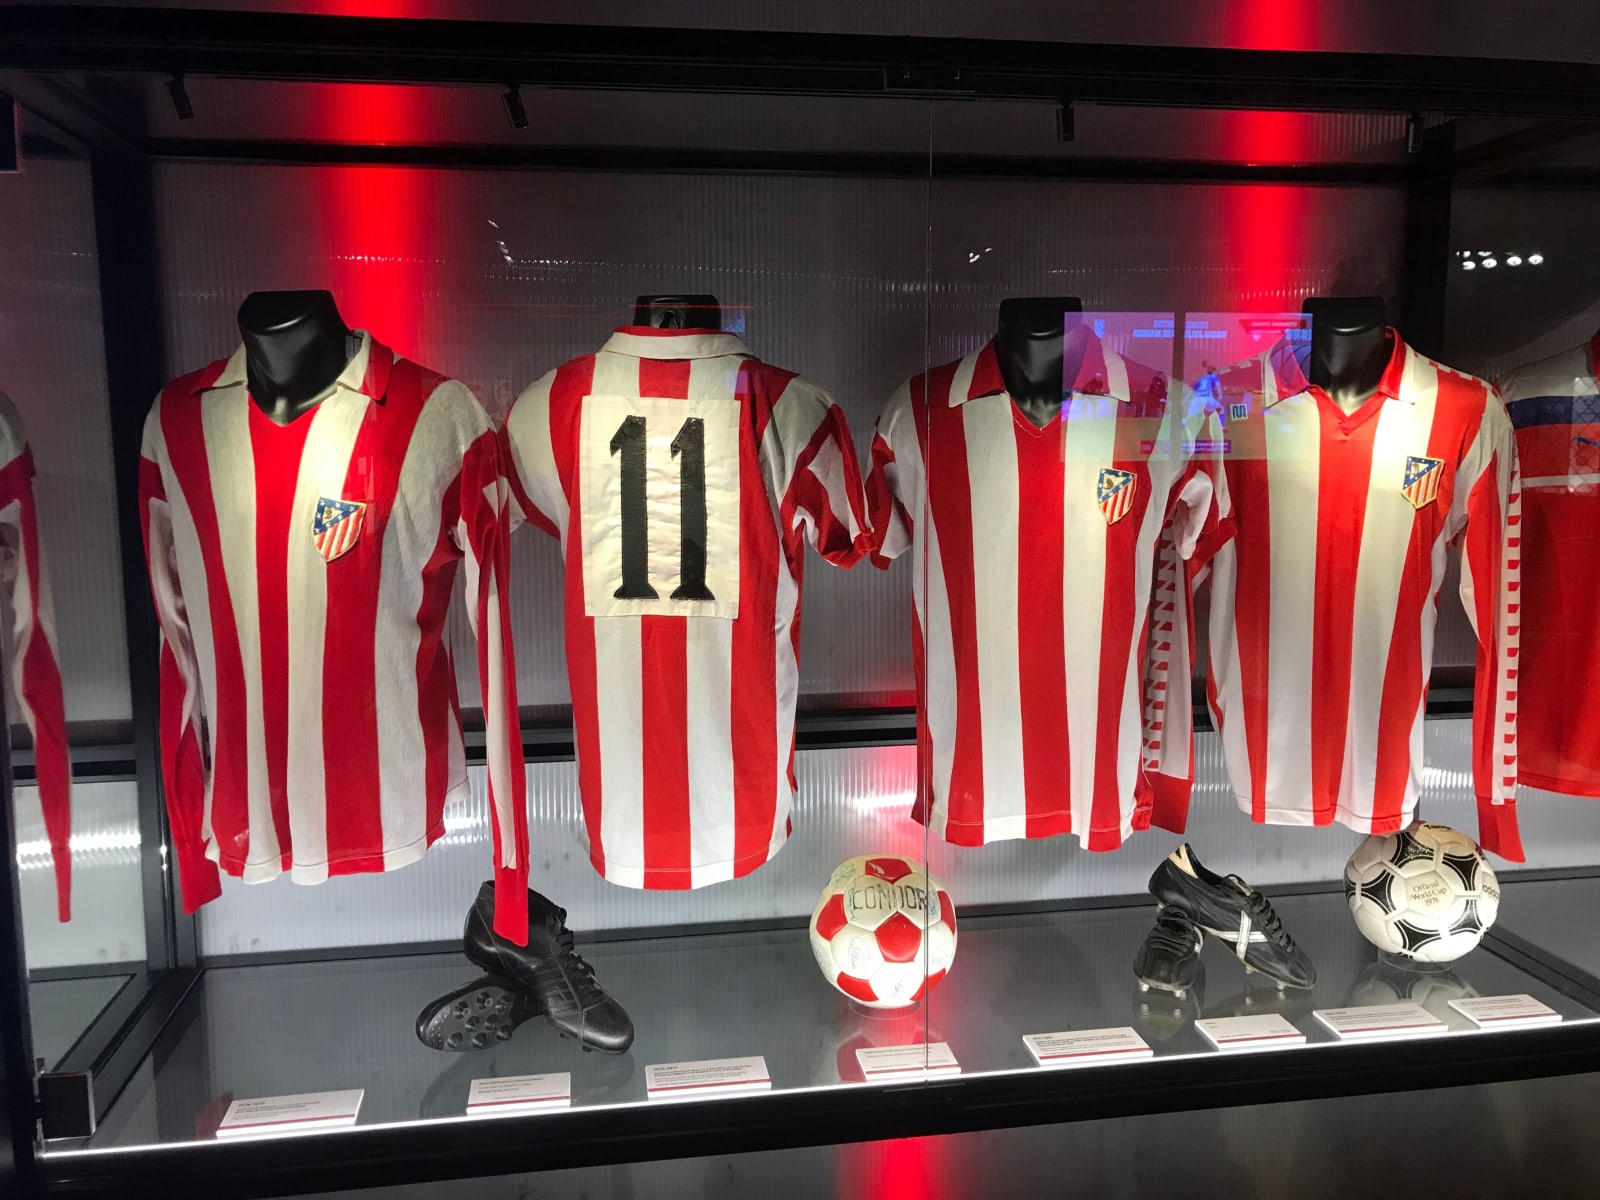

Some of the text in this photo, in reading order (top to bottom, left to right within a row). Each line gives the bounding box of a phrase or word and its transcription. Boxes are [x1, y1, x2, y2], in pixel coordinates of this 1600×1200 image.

[610, 415, 716, 601] 11
[1413, 880, 1440, 893] Official
[1411, 887, 1447, 901] World Cup
